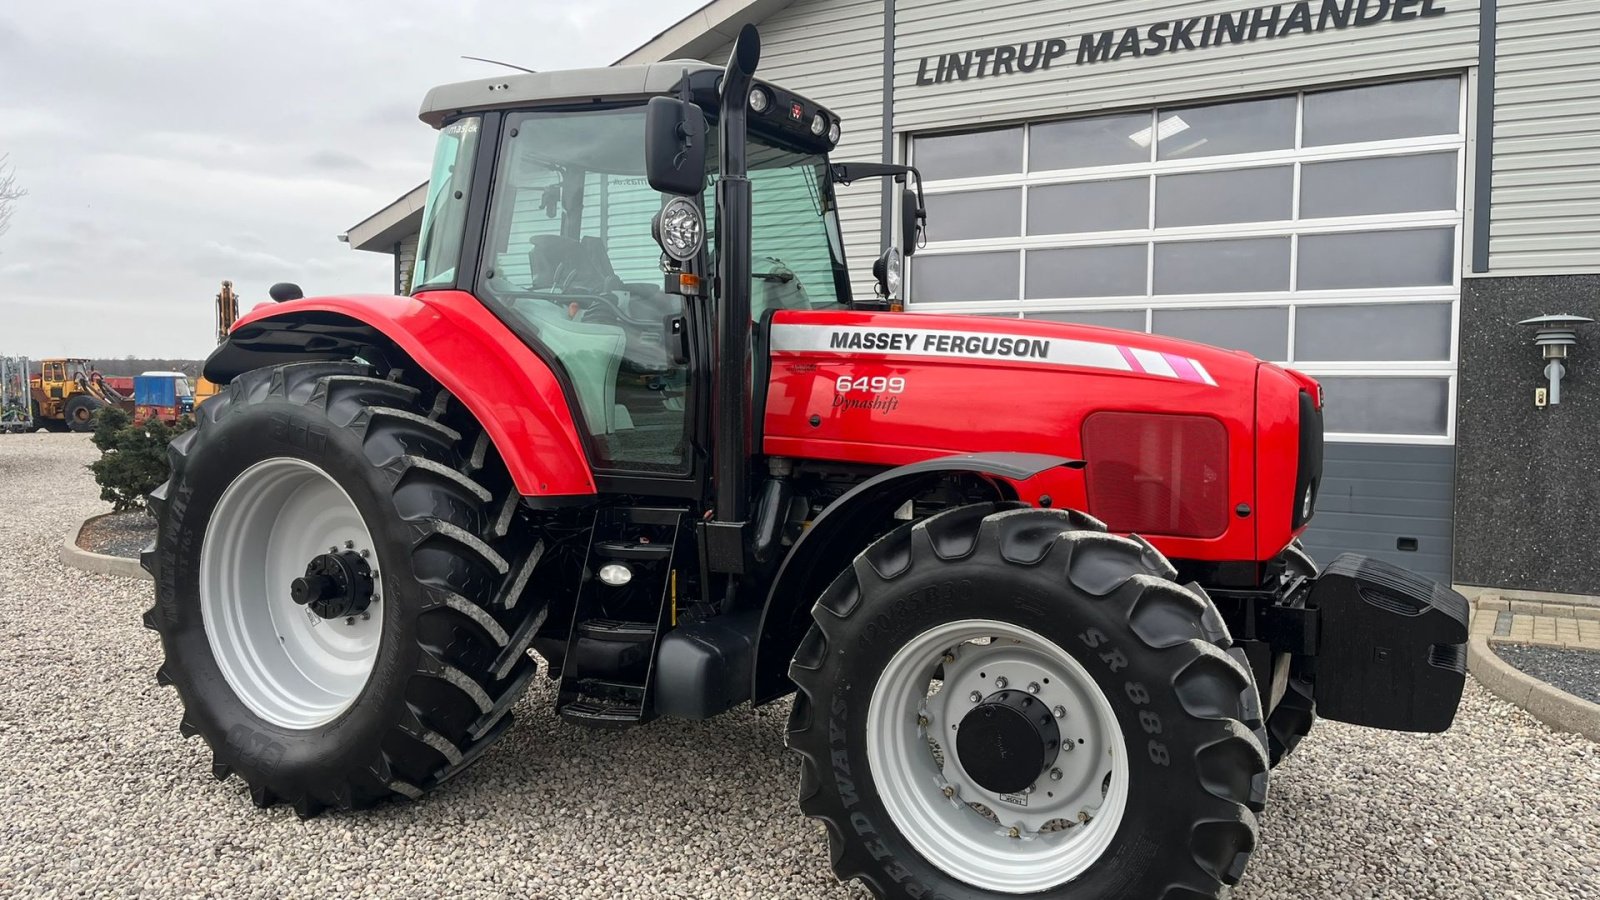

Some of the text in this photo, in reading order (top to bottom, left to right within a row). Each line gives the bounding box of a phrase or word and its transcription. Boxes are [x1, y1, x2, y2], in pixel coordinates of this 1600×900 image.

[915, 39, 1066, 86] LINTRUP
[829, 332, 1050, 359] MASSEY FERGUSON
[835, 375, 906, 394] 6499
[832, 393, 899, 415] Dynashift
[1078, 627, 1170, 767] SR 888
[828, 694, 950, 900] PEEDWAYS
